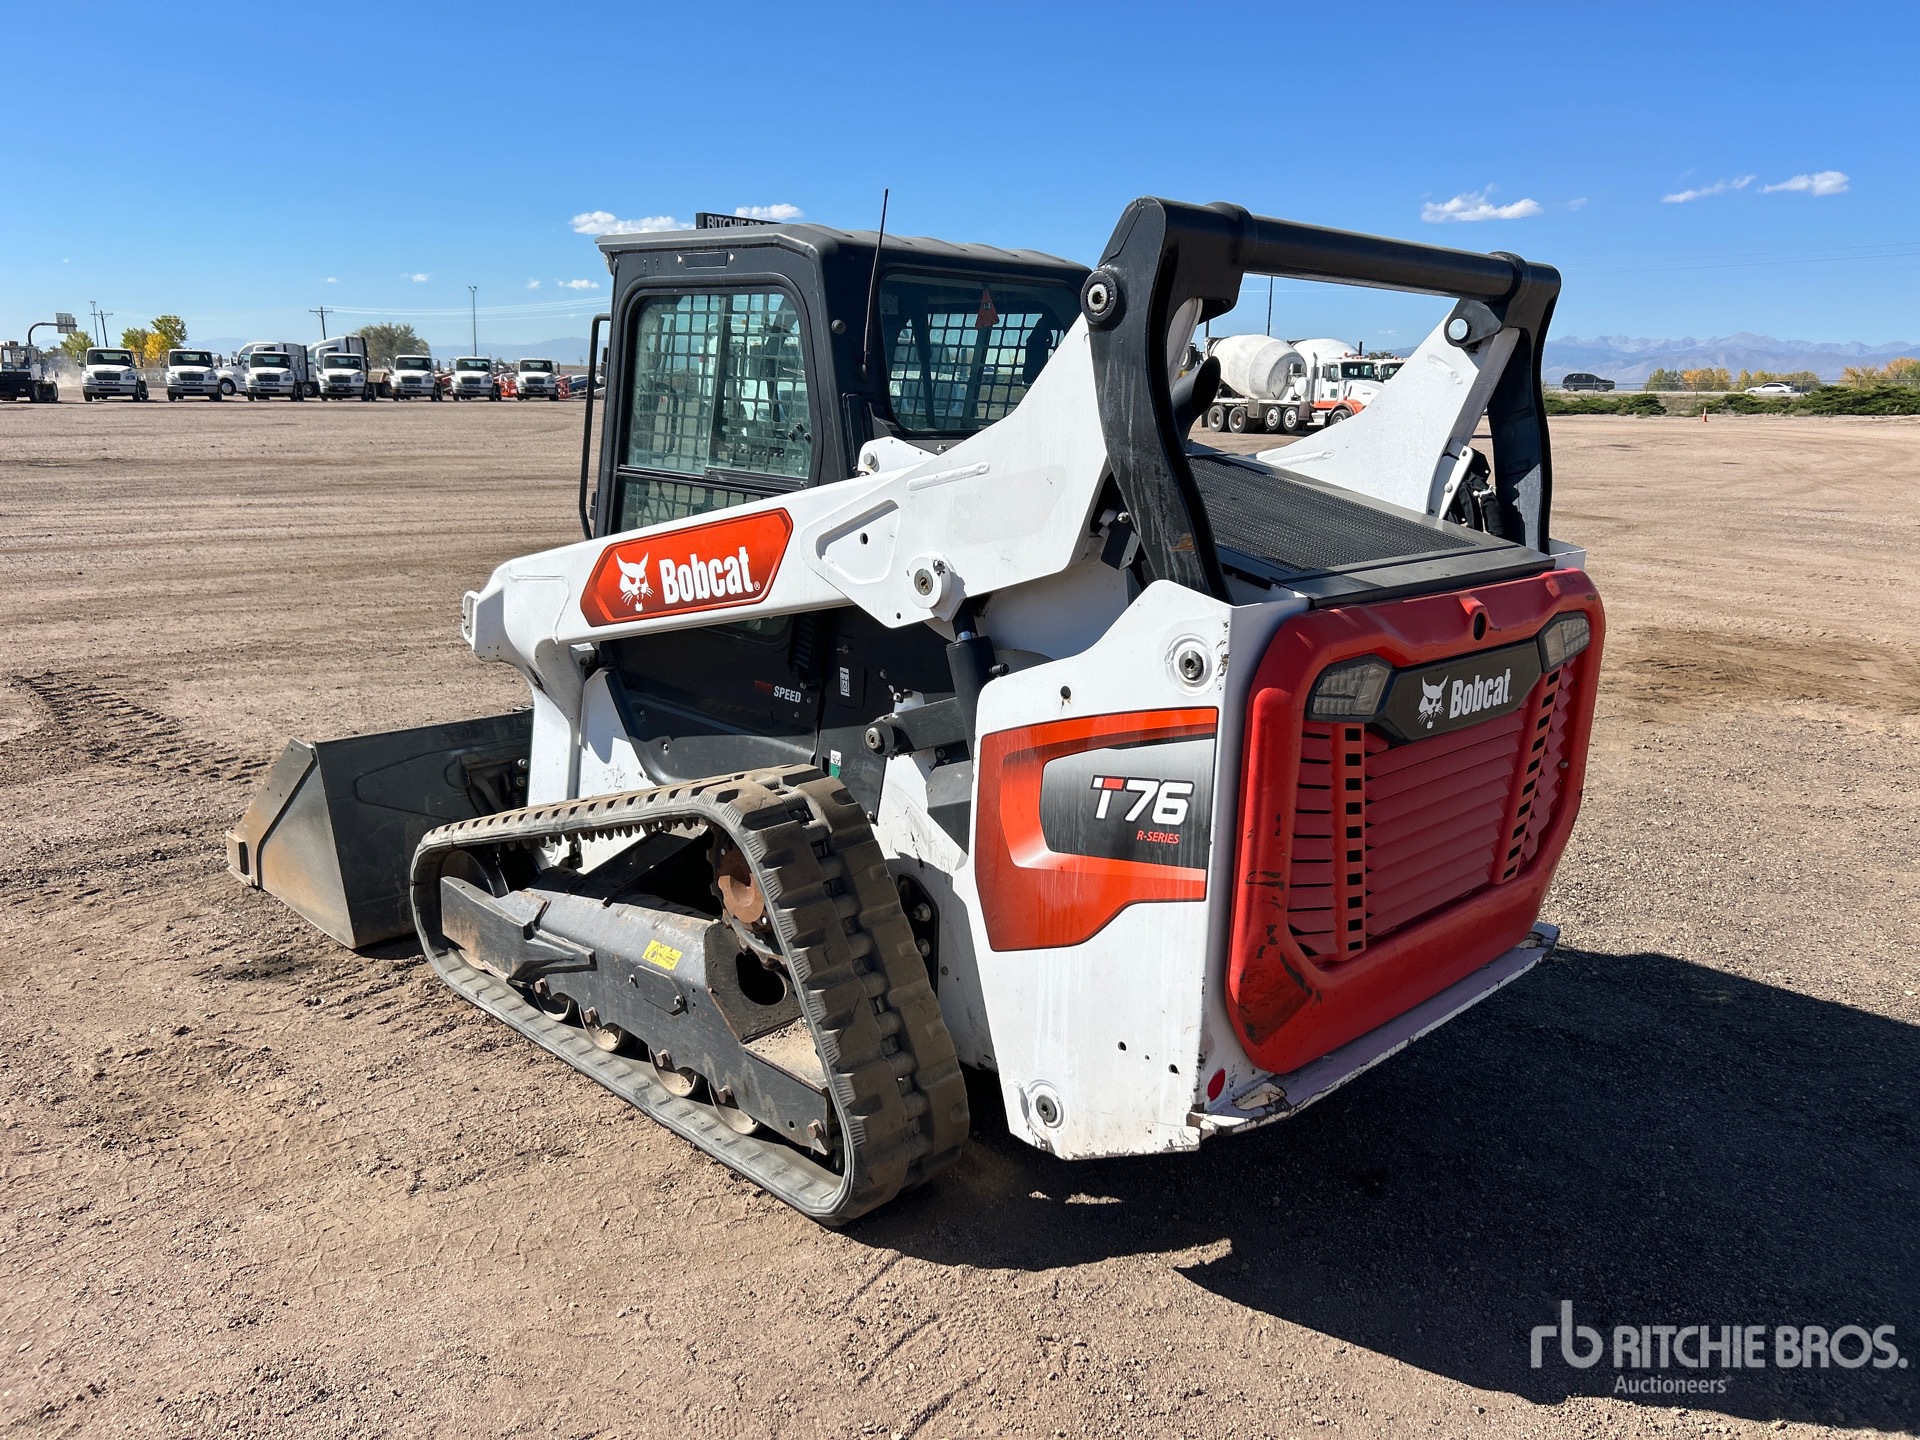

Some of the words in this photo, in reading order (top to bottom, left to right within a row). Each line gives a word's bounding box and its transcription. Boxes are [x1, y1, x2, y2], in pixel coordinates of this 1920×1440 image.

[773, 685, 802, 703] SPEED
[1090, 774, 1195, 826] T76
[1136, 829, 1180, 845] R-SERIES
